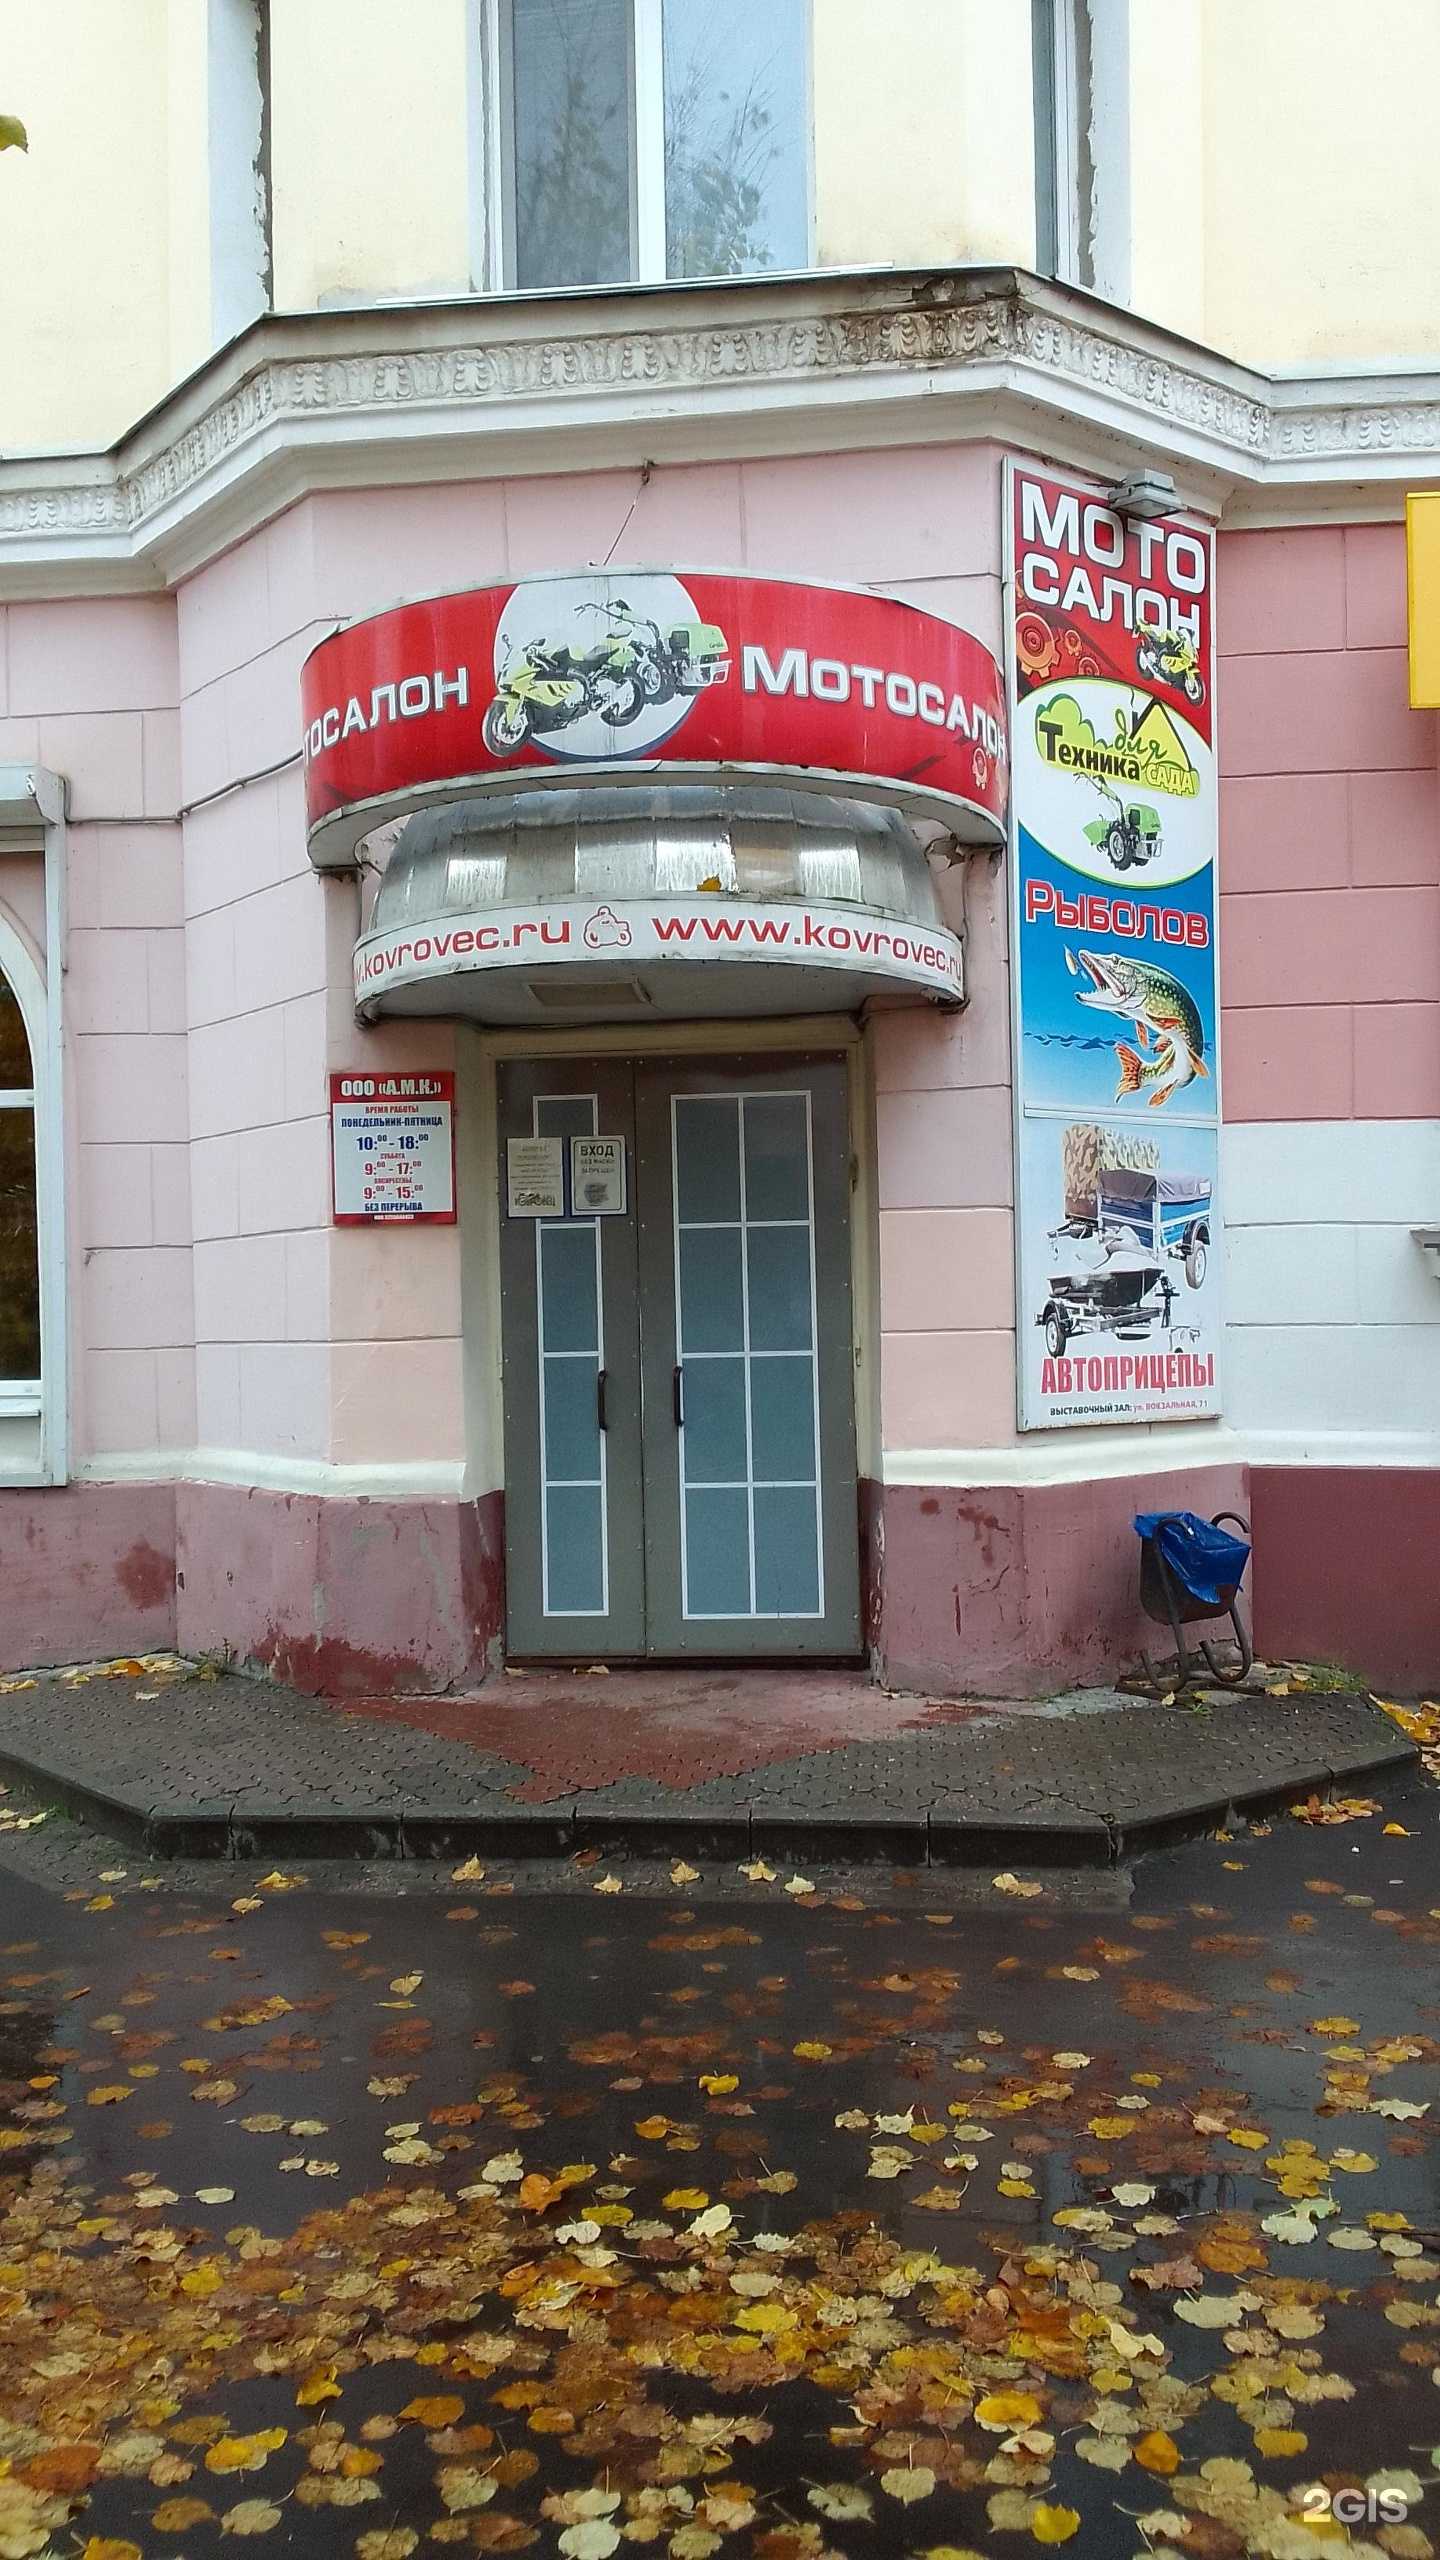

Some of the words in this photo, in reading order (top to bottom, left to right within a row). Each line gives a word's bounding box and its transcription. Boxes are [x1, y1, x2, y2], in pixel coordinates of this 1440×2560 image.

[1021, 480, 1206, 594] МОТО
[1023, 552, 1200, 649] САЛОН
[1039, 720, 1140, 781] Техника
[1145, 762, 1196, 796] САДА
[1025, 879, 1210, 949] РЫБОЛОВ
[651, 914, 961, 981] www.kovrovec.ru
[341, 1080, 375, 1096] ООО
[581, 1145, 614, 1157] ВХОД
[365, 1203, 379, 1211] БЕЗ
[381, 1202, 422, 1211] ПЕРЕРЫВА
[1041, 1353, 1214, 1394] АВТОПРИЦЕПЫ
[1050, 1404, 1113, 1416] ВЫСТАВОЧНЫЙ
